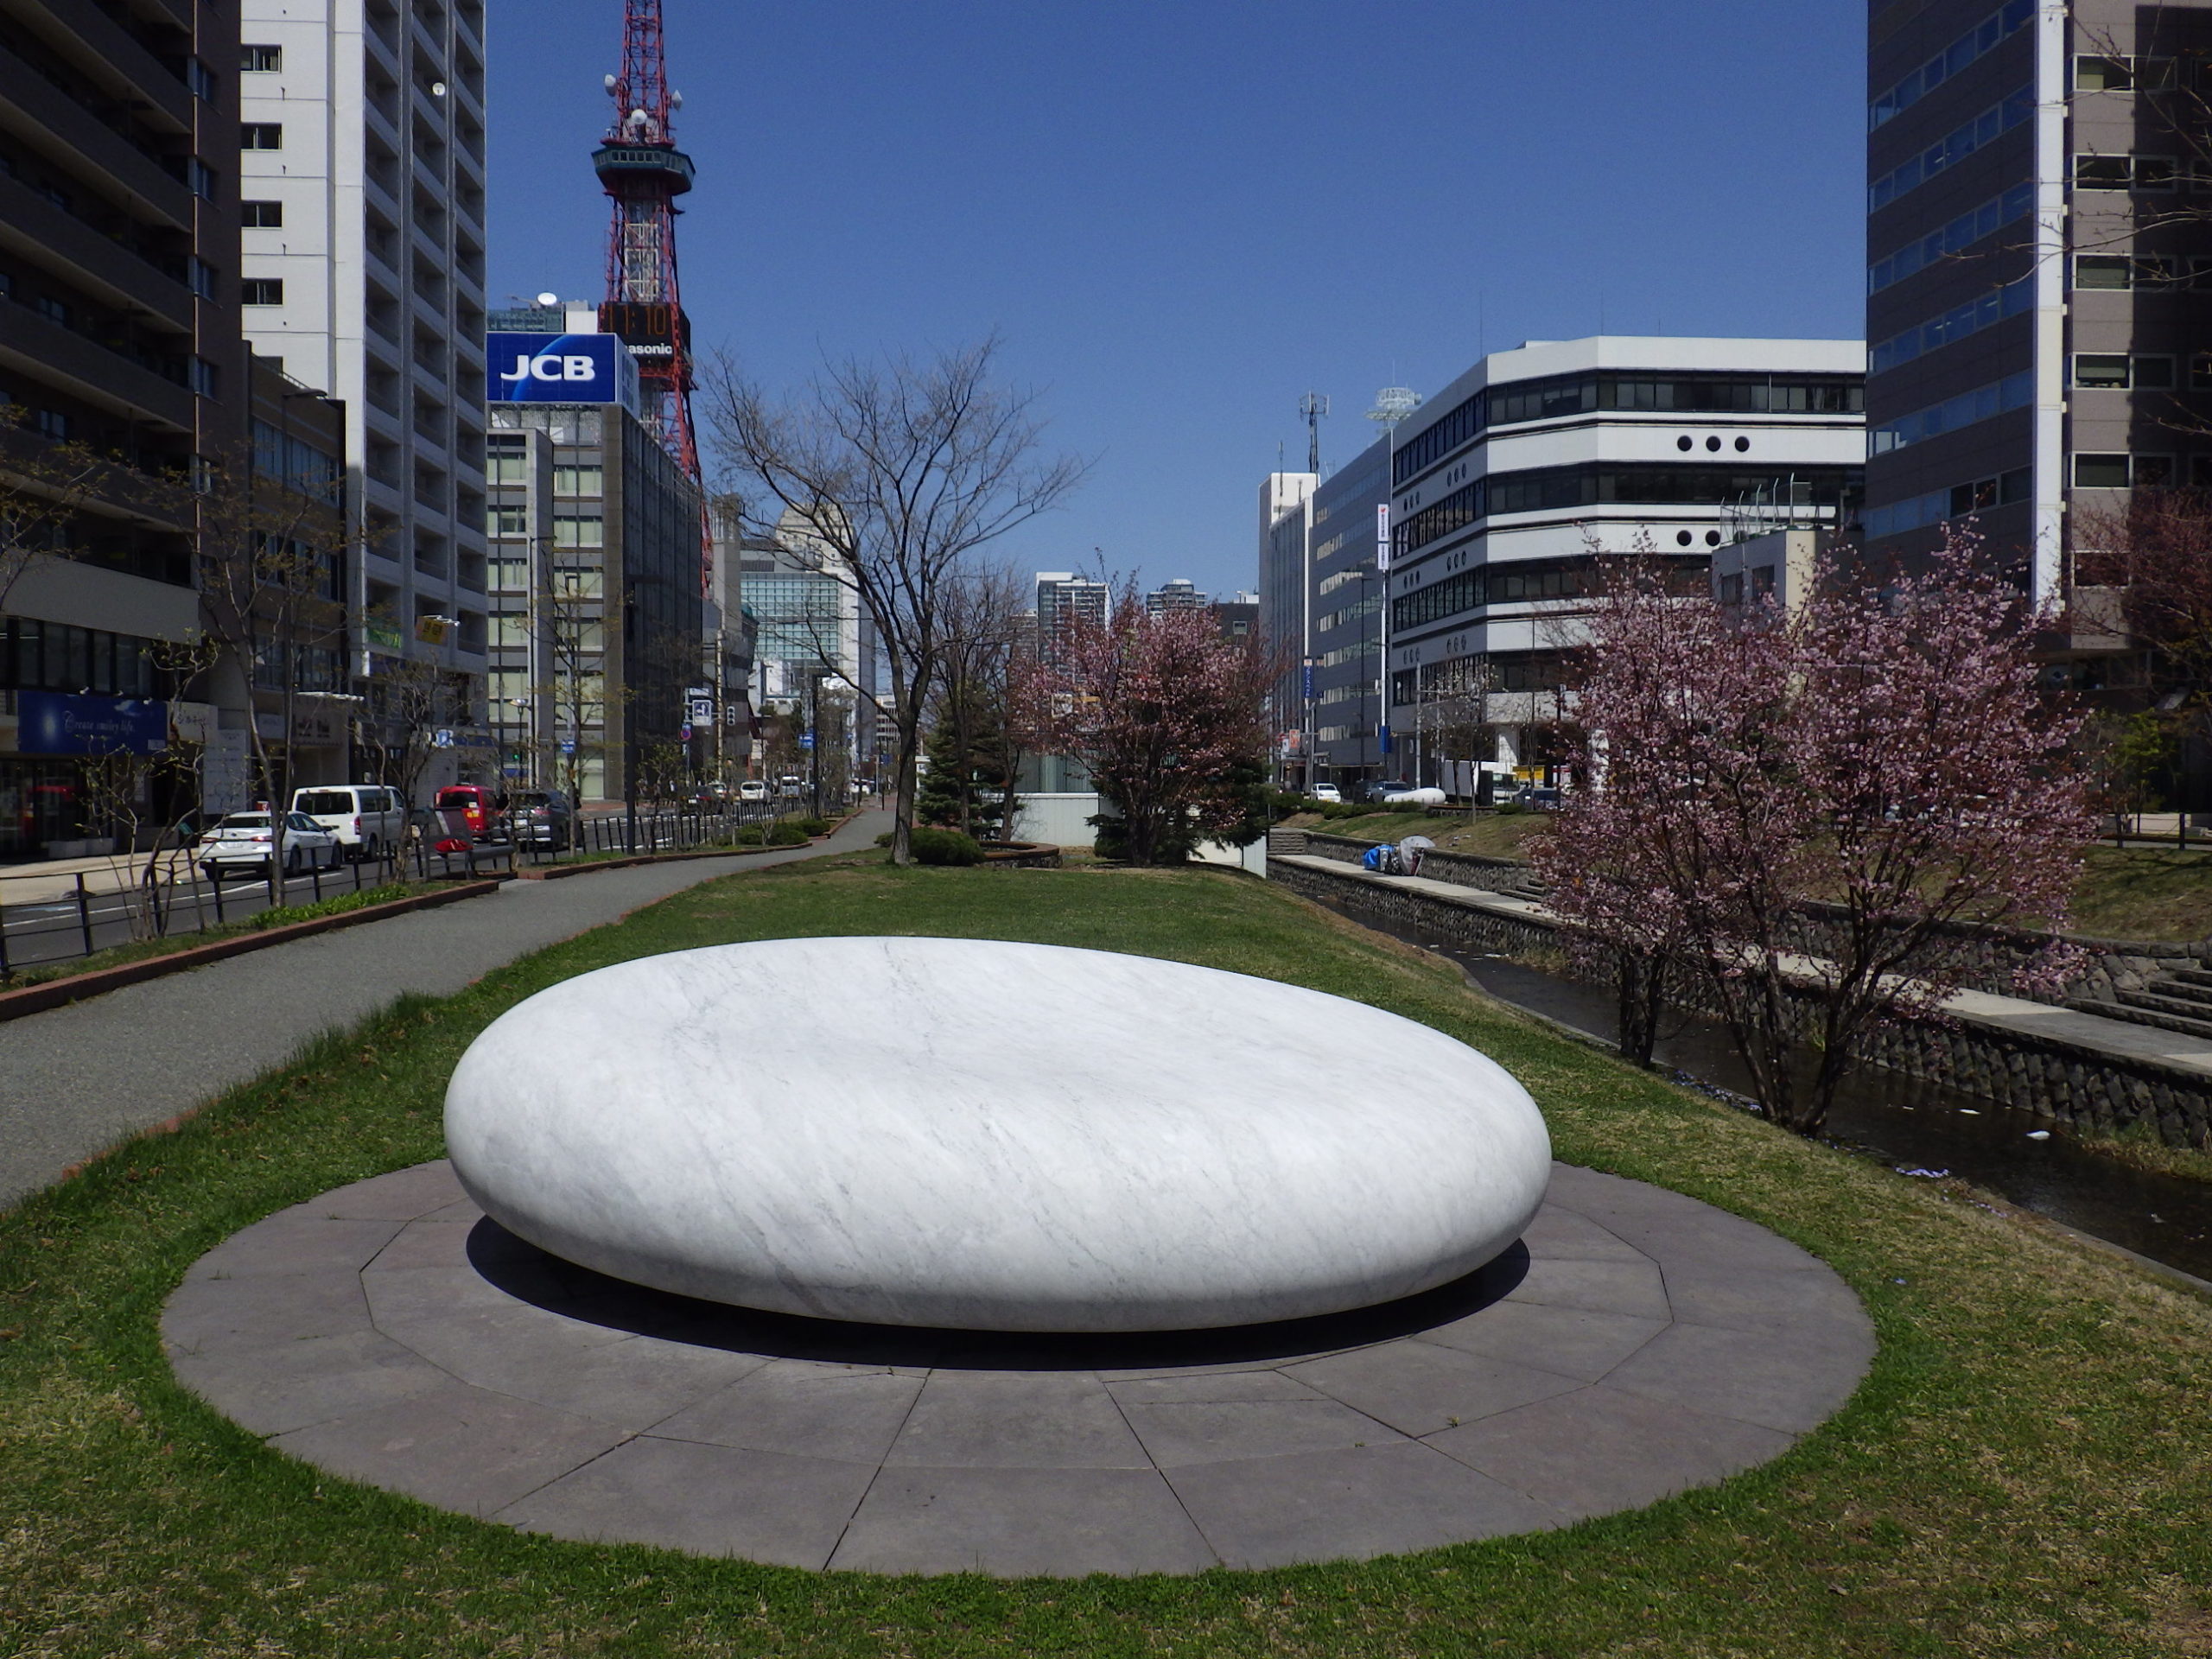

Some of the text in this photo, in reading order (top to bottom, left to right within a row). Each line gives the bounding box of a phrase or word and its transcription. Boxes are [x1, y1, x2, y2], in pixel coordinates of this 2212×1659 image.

[607, 305, 666, 335] 11:10
[626, 342, 672, 354] asonic
[500, 354, 596, 381] JCB
[63, 710, 93, 733] Create
[96, 718, 119, 734] smiley
